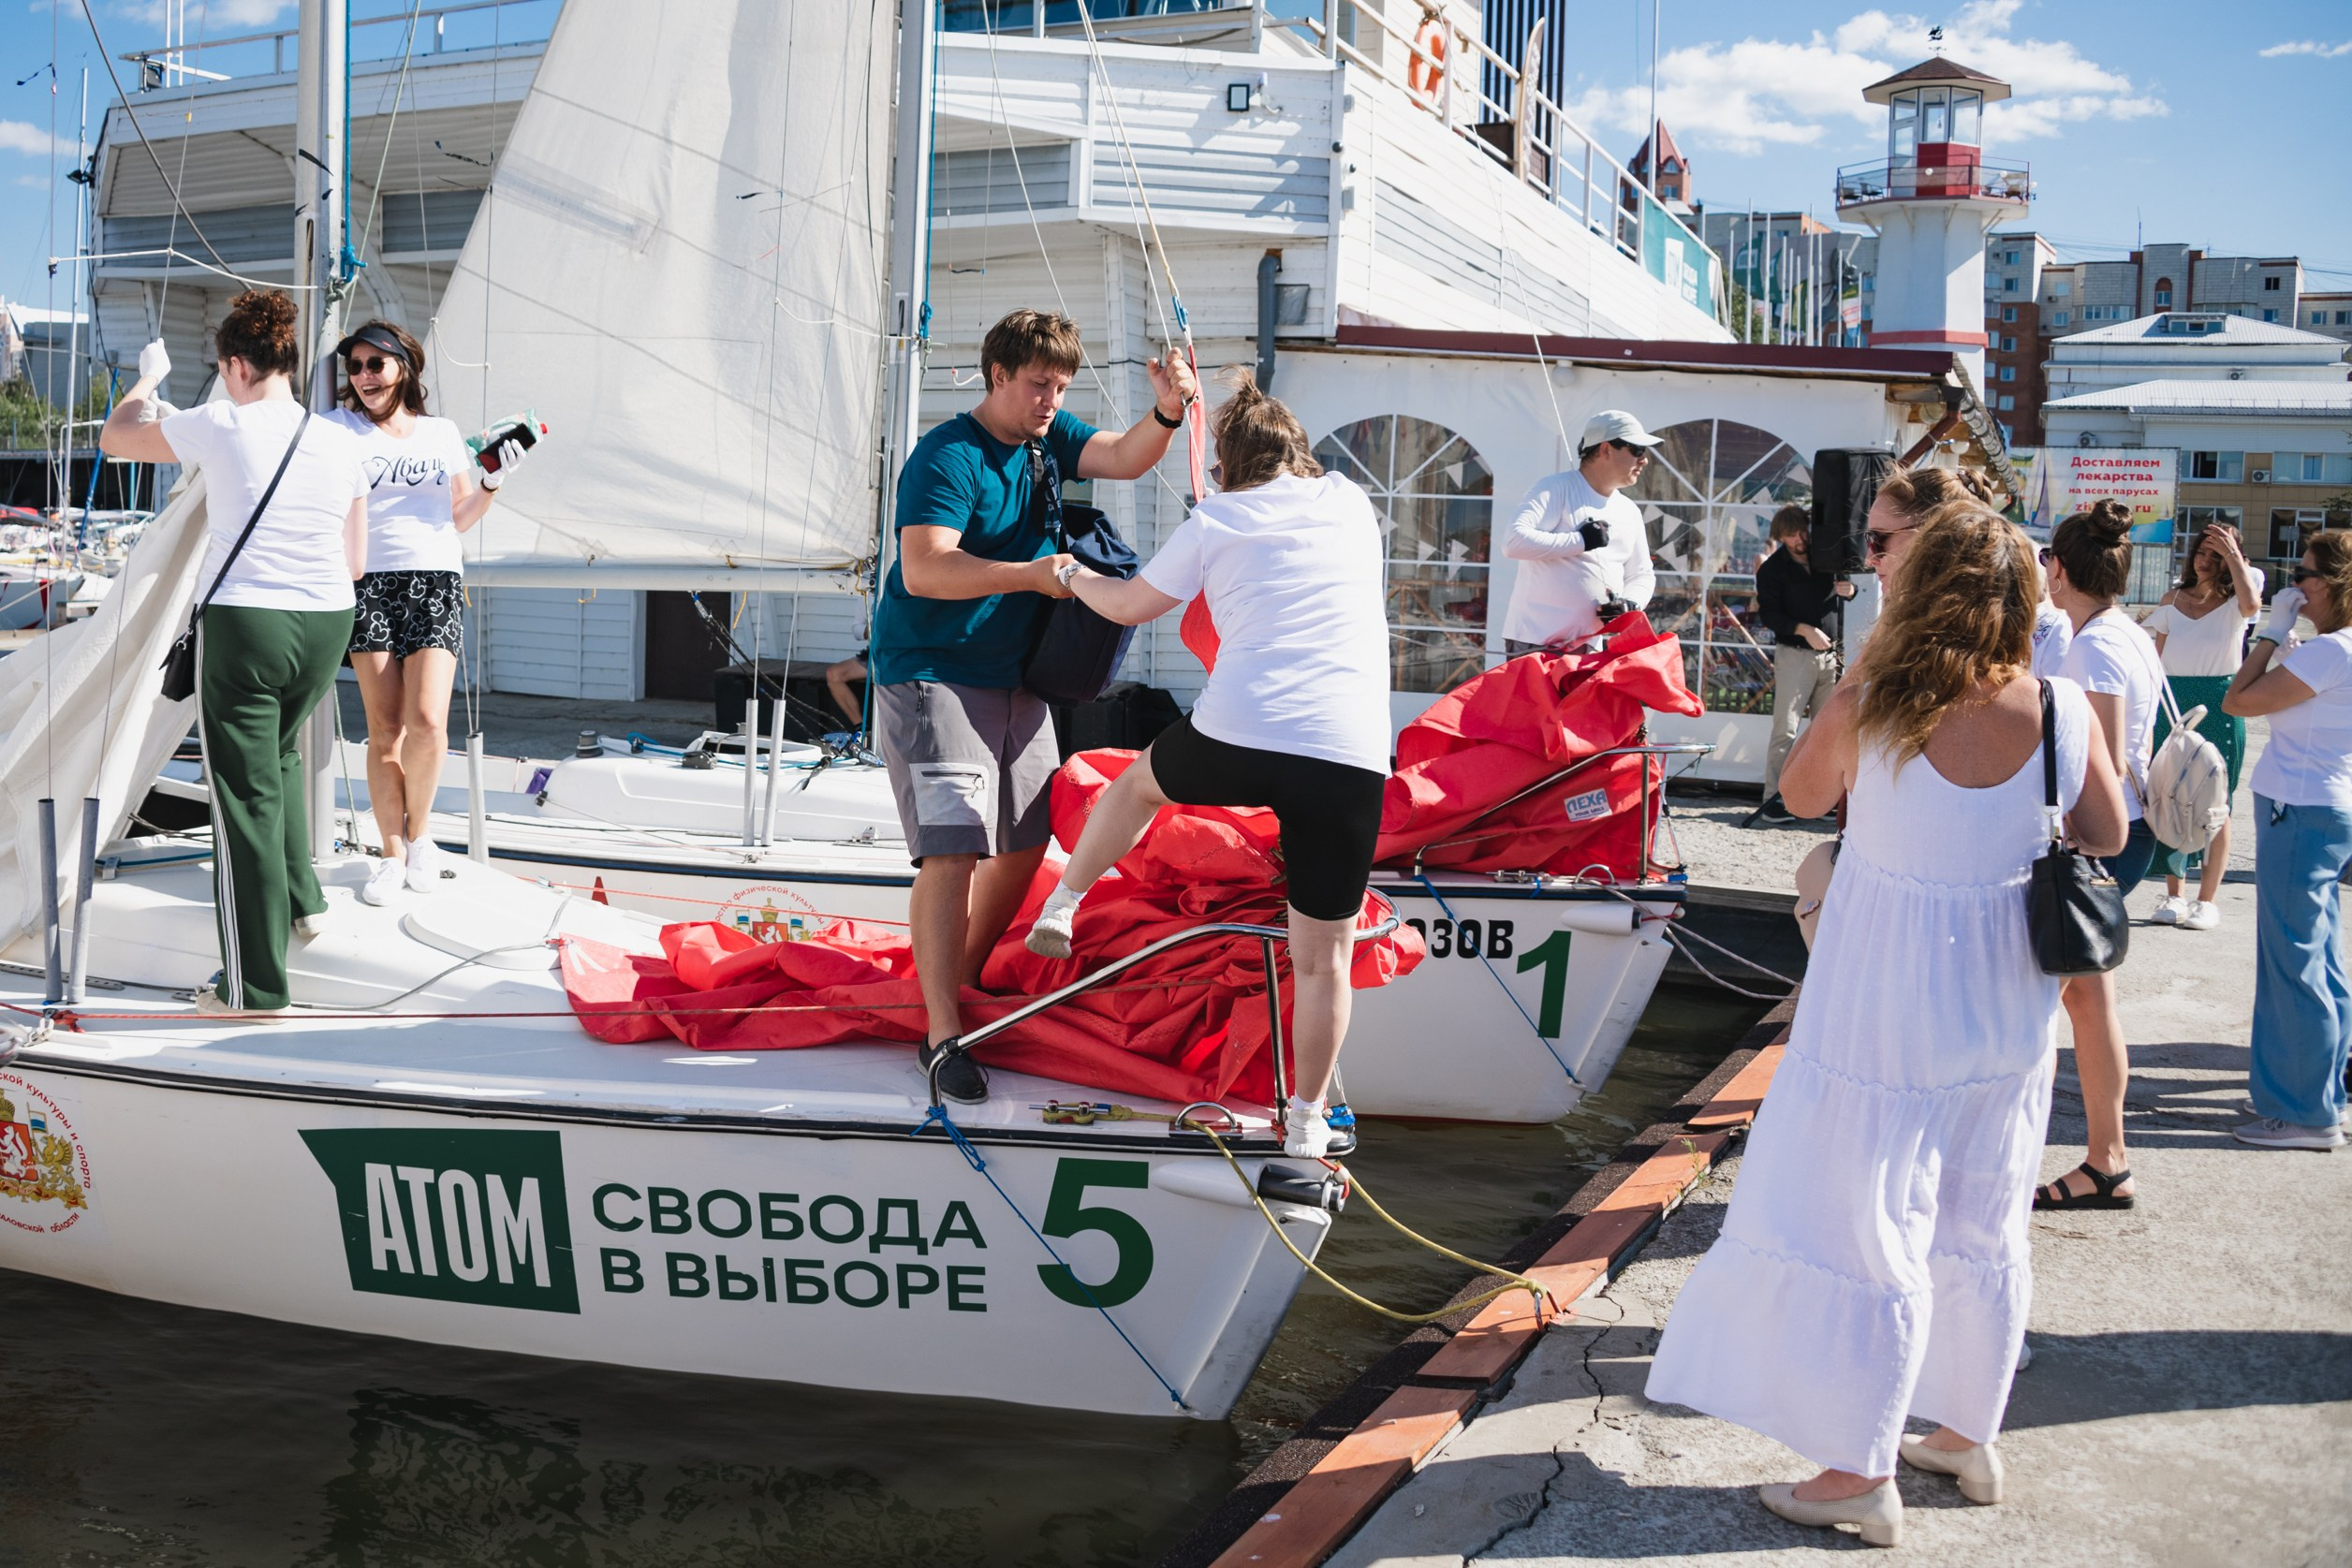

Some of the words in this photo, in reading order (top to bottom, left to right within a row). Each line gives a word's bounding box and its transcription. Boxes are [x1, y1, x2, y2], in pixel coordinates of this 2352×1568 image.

[2070, 457, 2160, 468] Доставляем
[2076, 471, 2154, 483] лекарства
[2112, 488, 2158, 497] парусах
[733, 885, 788, 901] физической
[790, 892, 825, 925] культуы
[1516, 930, 1572, 1039] 1
[26, 1083, 72, 1129] культуры
[76, 1144, 91, 1190] спорта
[50, 1212, 81, 1232] области
[364, 1162, 552, 1288] АТОМ
[592, 1183, 988, 1255] СВОБОДА
[1036, 1157, 1154, 1309] 5
[600, 1248, 644, 1294] В
[665, 1252, 988, 1312] ВЫБОРЕ
